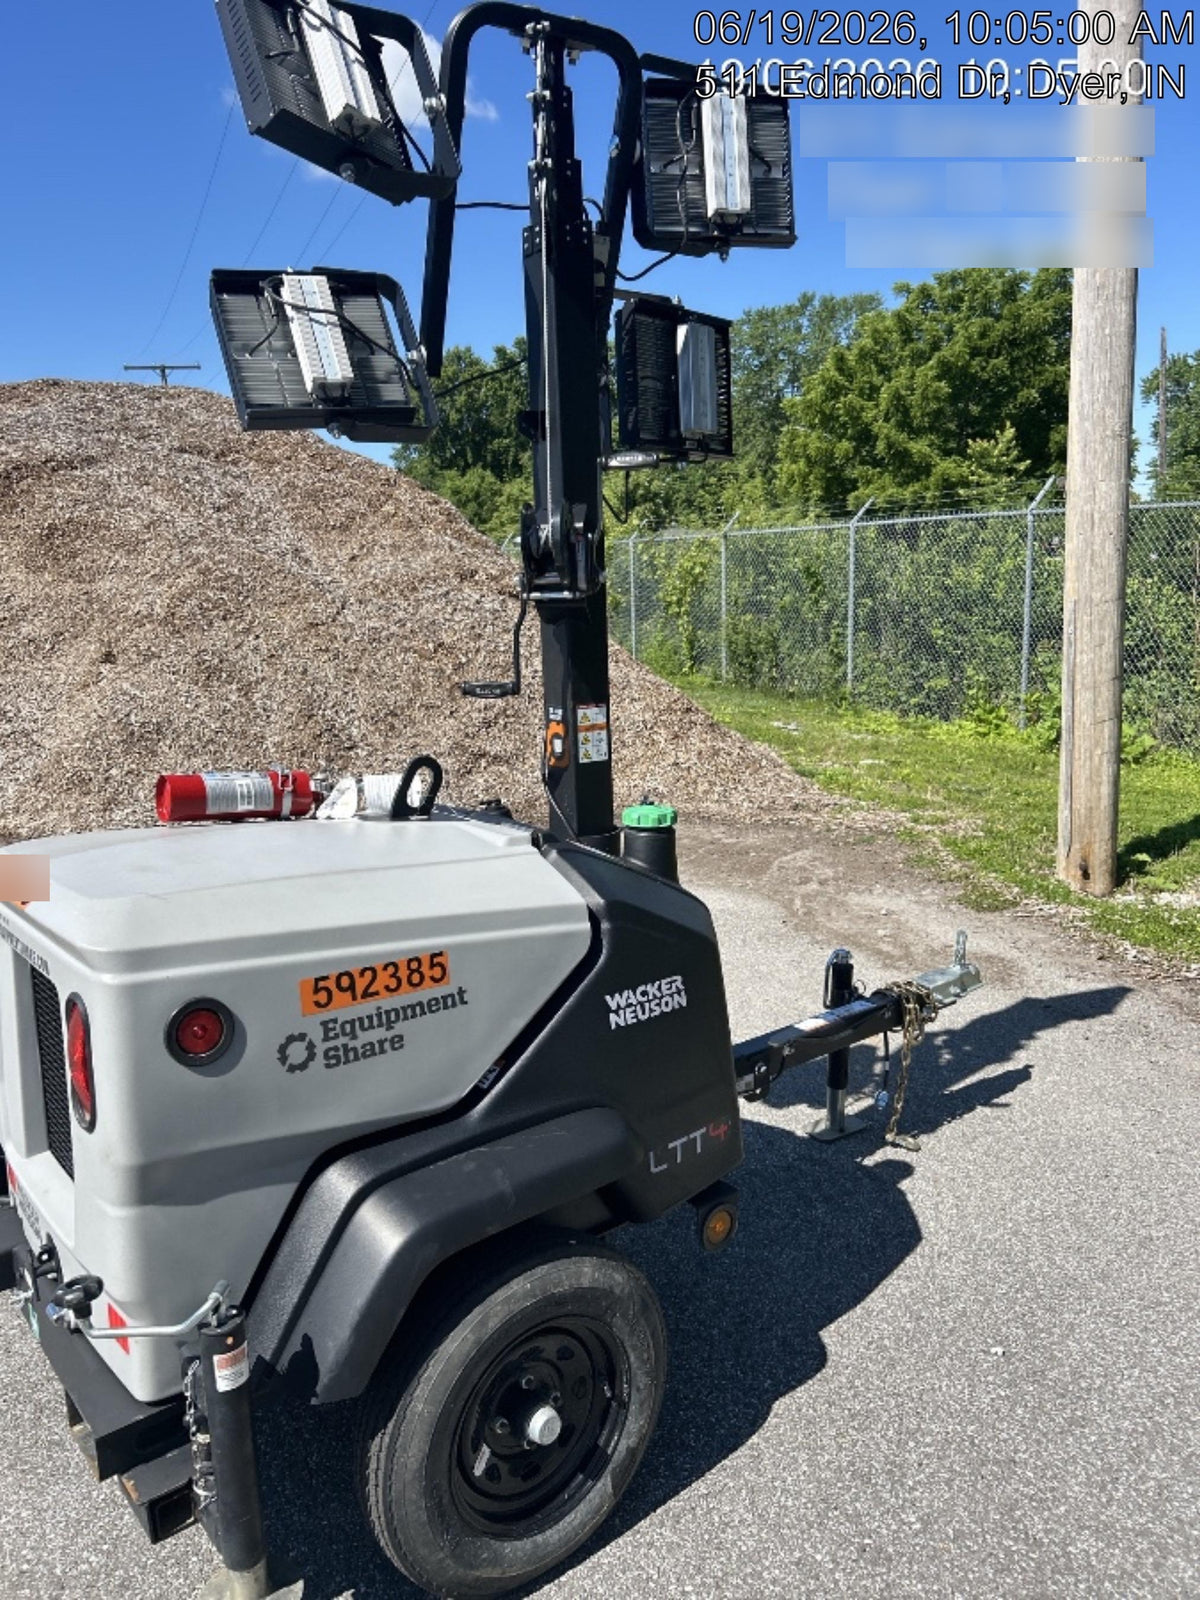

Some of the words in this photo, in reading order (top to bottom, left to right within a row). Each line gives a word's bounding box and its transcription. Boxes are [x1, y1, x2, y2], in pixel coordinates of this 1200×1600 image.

[312, 950, 448, 1009] 592385
[604, 974, 686, 1011] WACKER
[319, 985, 469, 1043] Equipment
[608, 990, 688, 1031] NEUSON
[322, 1032, 405, 1070] Share
